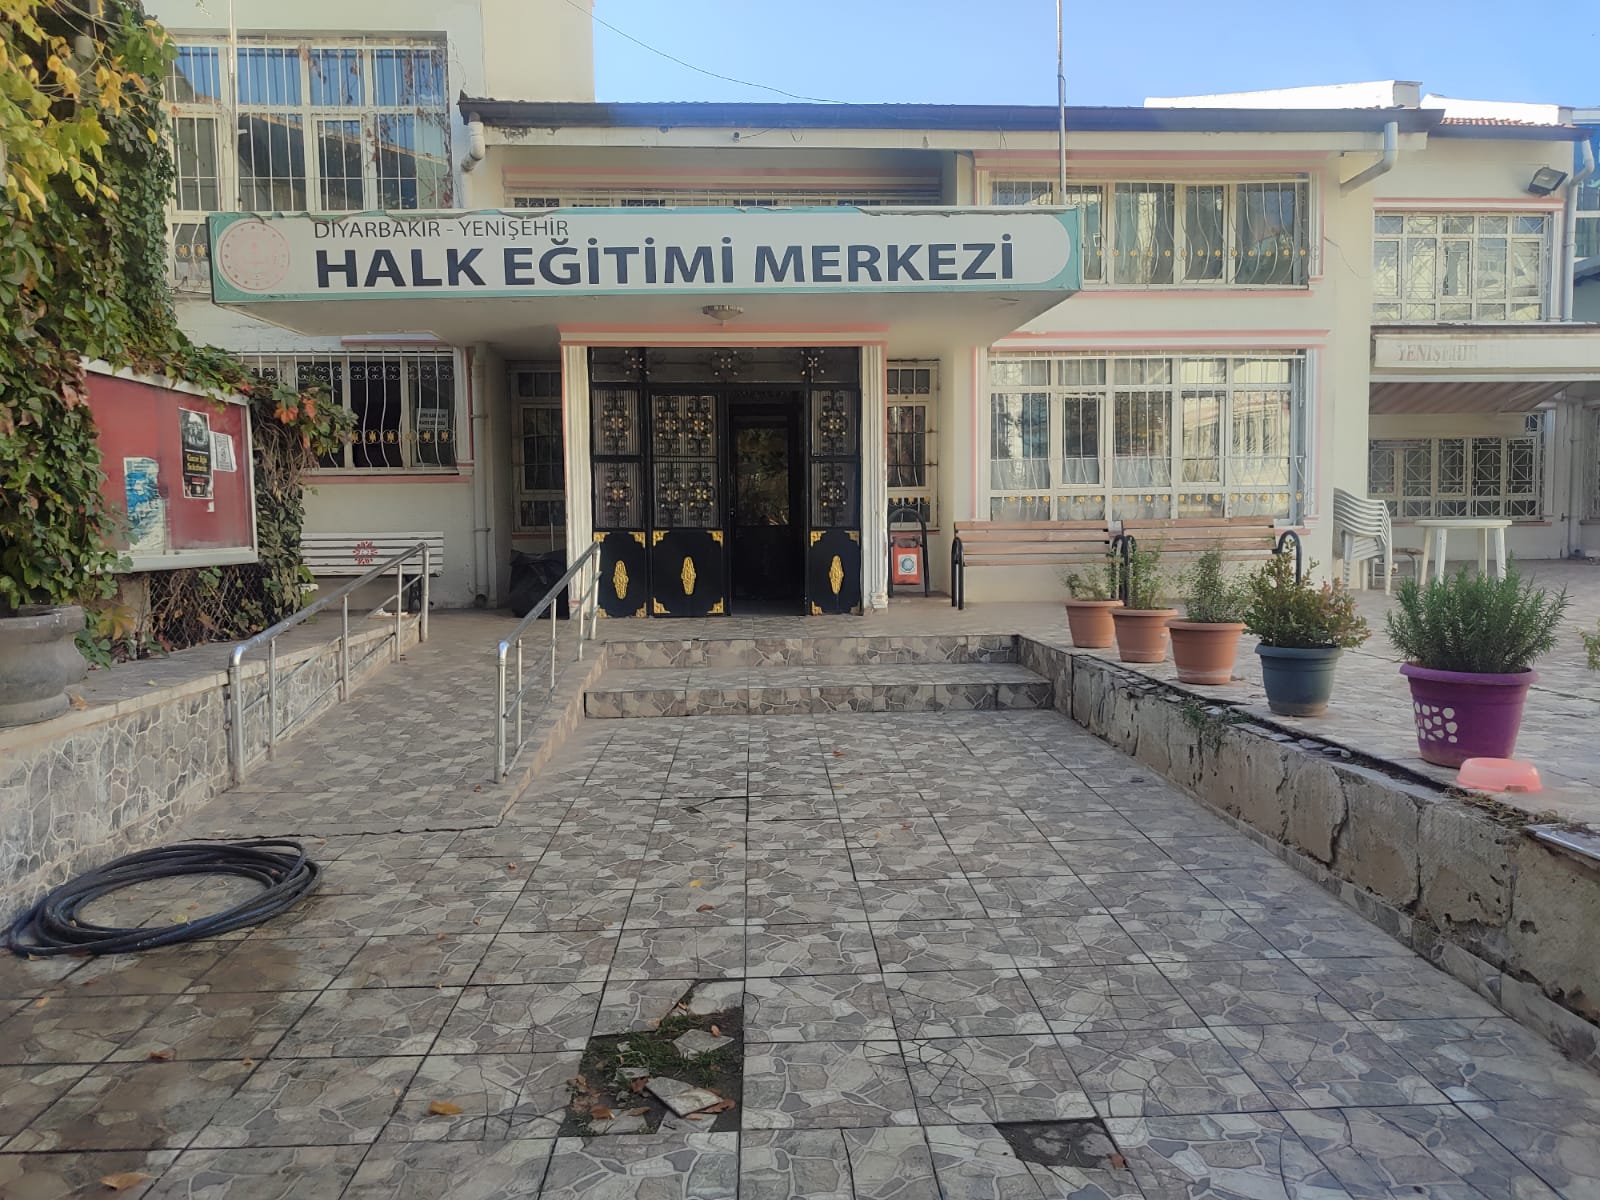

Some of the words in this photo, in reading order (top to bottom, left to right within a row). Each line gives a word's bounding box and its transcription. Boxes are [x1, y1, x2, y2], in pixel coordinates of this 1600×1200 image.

[314, 219, 441, 239] DİYARBAKIR
[458, 218, 569, 240] YENİŞEHİR
[315, 248, 487, 288] HALK
[504, 236, 734, 287] EĞİTİMİ
[754, 233, 1013, 284] MERKEZİ
